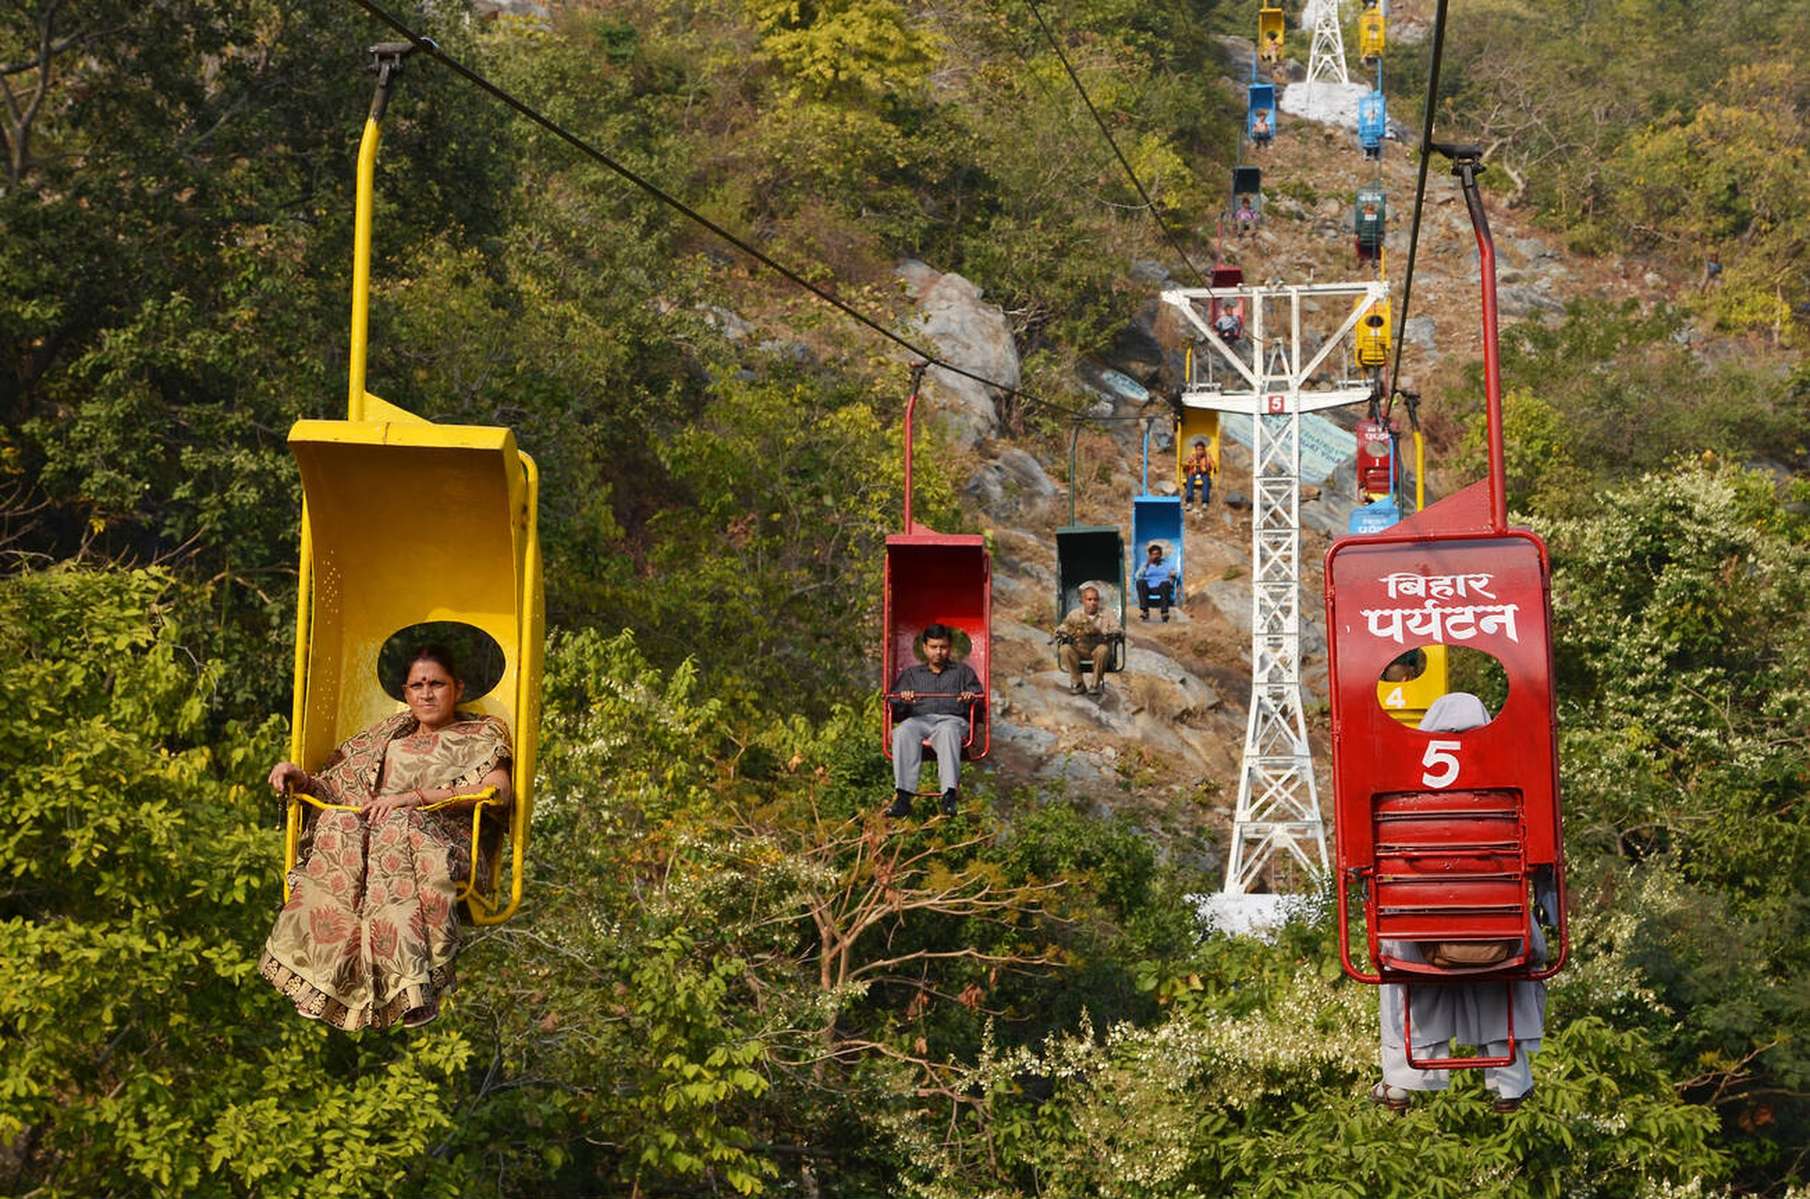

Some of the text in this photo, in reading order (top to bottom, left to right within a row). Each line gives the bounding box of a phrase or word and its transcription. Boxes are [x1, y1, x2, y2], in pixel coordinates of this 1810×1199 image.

[1271, 397, 1282, 411] 5
[1378, 572, 1497, 600] बिहार
[1360, 599, 1520, 644] पर्यटन
[1385, 687, 1407, 709] 4
[1422, 740, 1462, 789] 5
